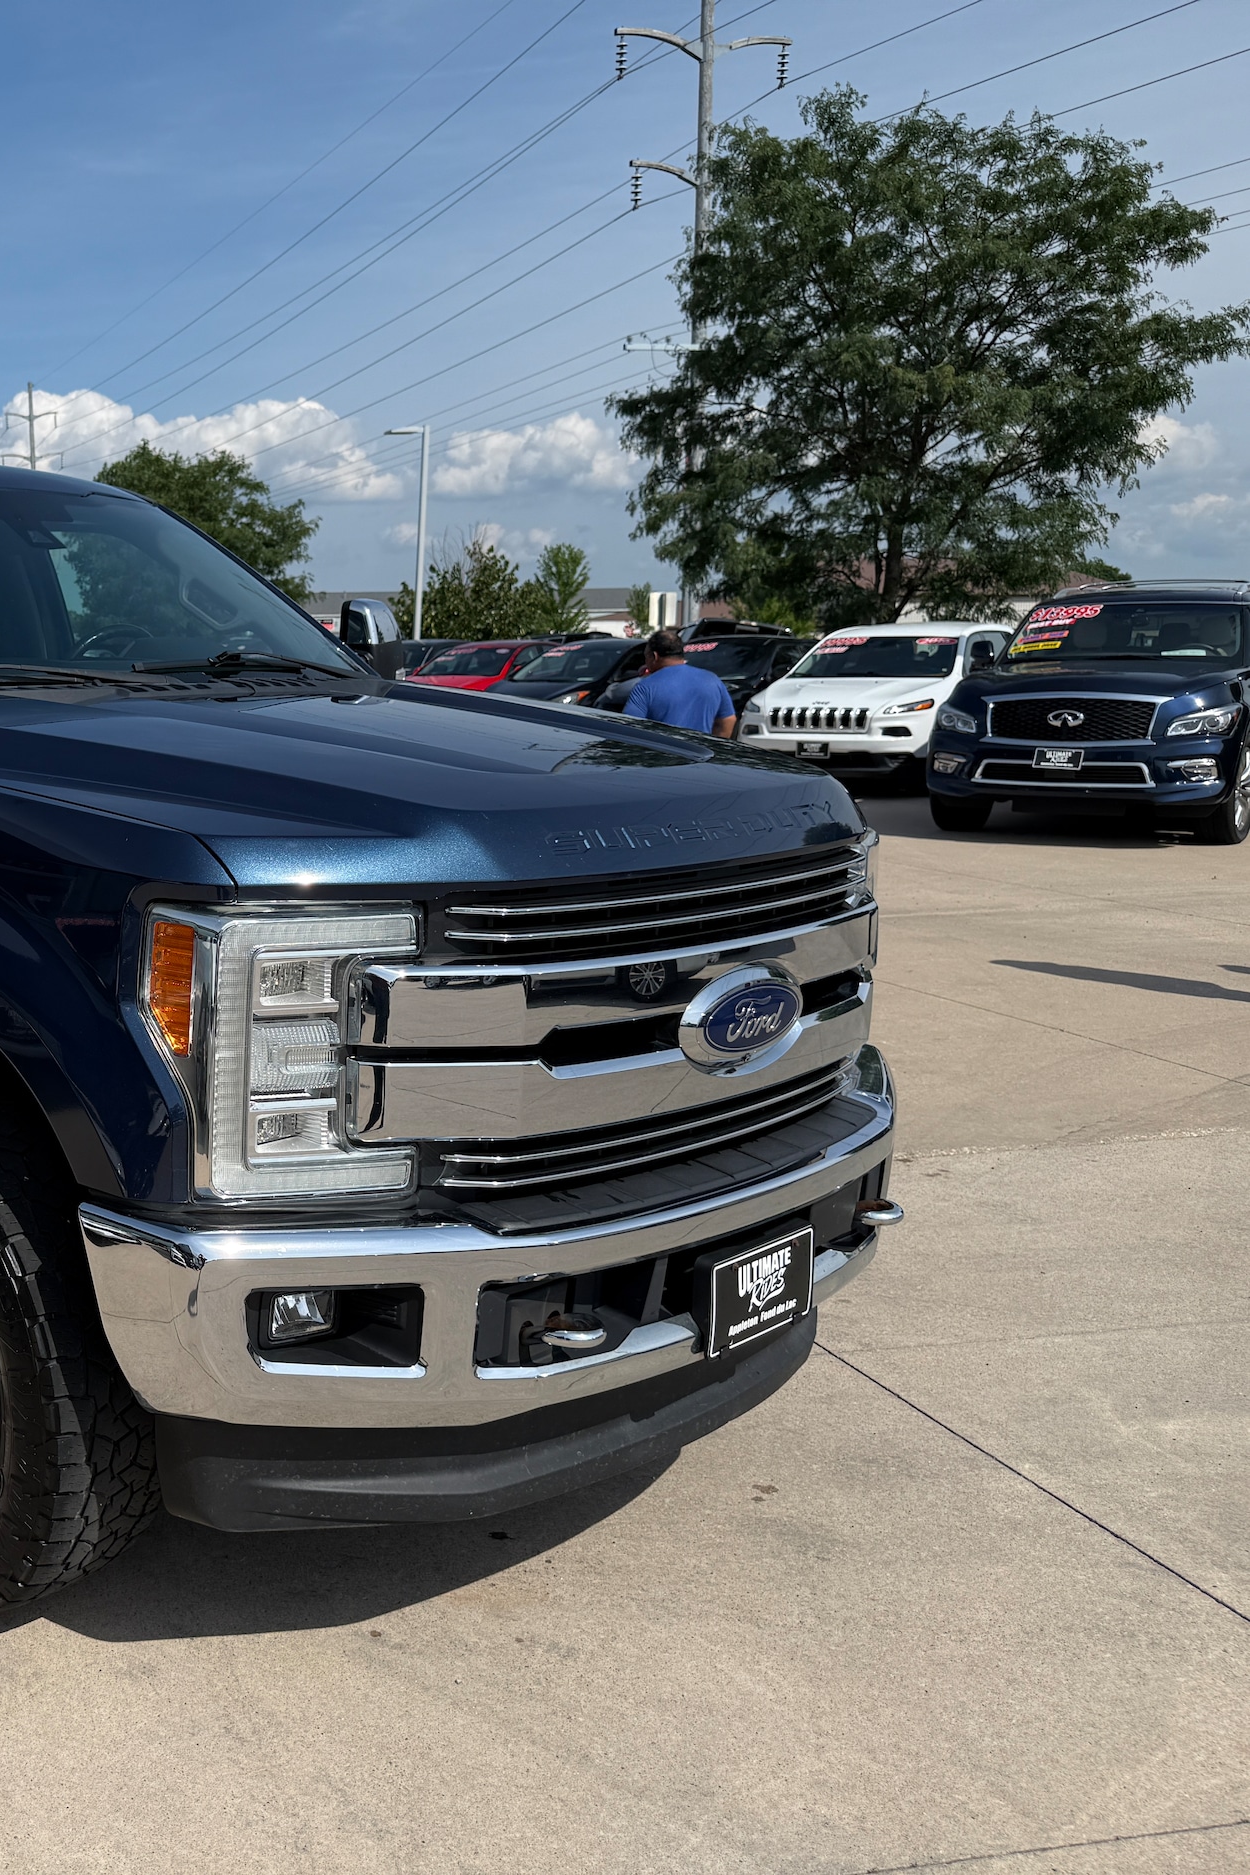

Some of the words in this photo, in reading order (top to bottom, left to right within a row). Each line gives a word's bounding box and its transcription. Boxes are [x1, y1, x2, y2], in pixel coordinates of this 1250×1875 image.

[1030, 604, 1104, 621] $13995
[545, 818, 738, 857] SUPER
[738, 800, 836, 834] DUTY
[726, 995, 785, 1042] Ford
[737, 1246, 792, 1298] ULTIMATE
[728, 1315, 759, 1337] Appleton
[760, 1306, 776, 1323] Fond
[776, 1302, 785, 1316] du
[785, 1298, 797, 1312] Lac
